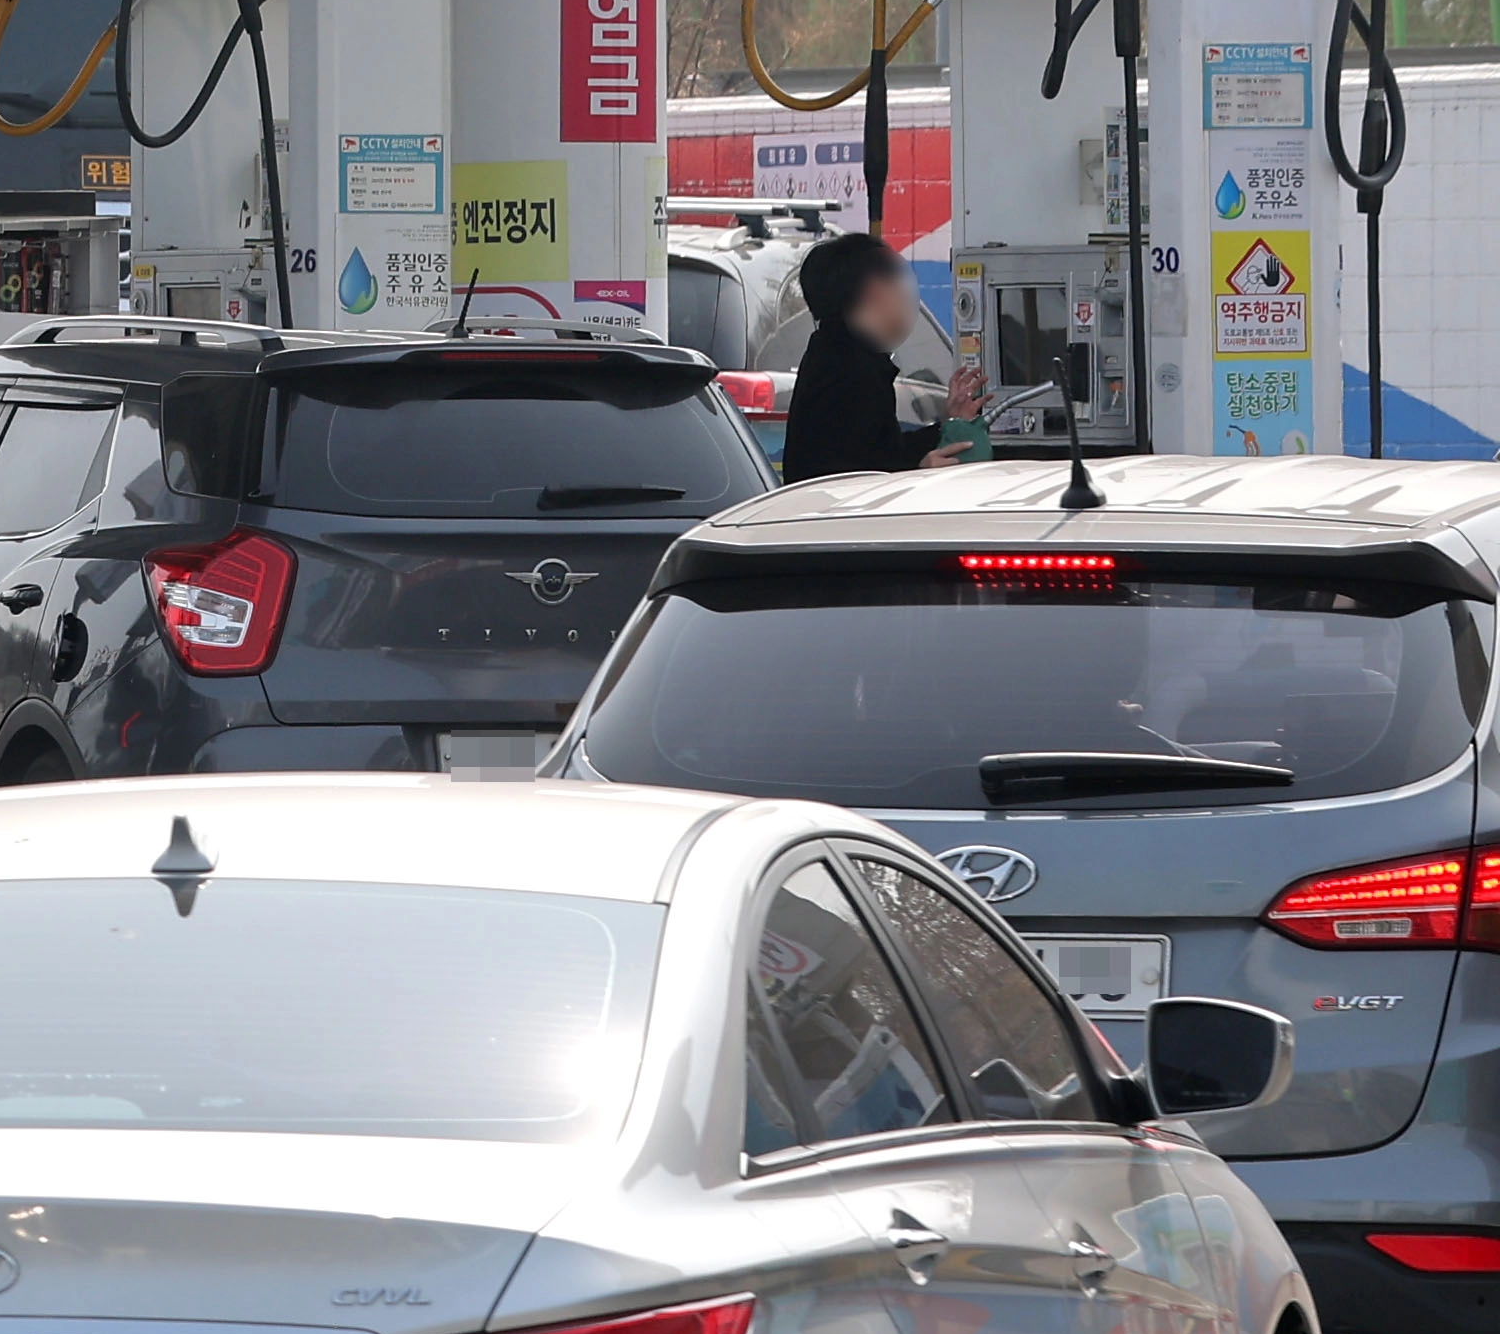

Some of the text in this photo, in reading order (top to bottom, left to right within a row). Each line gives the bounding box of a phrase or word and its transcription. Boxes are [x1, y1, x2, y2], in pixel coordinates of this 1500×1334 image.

[1225, 46, 1255, 60] CCTV
[361, 137, 390, 150] CCTV
[86, 160, 131, 185] 위험
[1246, 168, 1305, 189] 품질인증
[1254, 190, 1298, 210] 주유소
[462, 197, 557, 245] 엔진정지
[290, 247, 318, 274] 26
[385, 252, 449, 274] 품질인증
[1151, 247, 1180, 274] 30
[385, 295, 449, 309] 한국석유관리원
[1220, 300, 1301, 324] 역주행금지
[1226, 371, 1297, 395] 탄소중립
[1227, 395, 1298, 418] 실천하기
[439, 627, 618, 643] TIVOL
